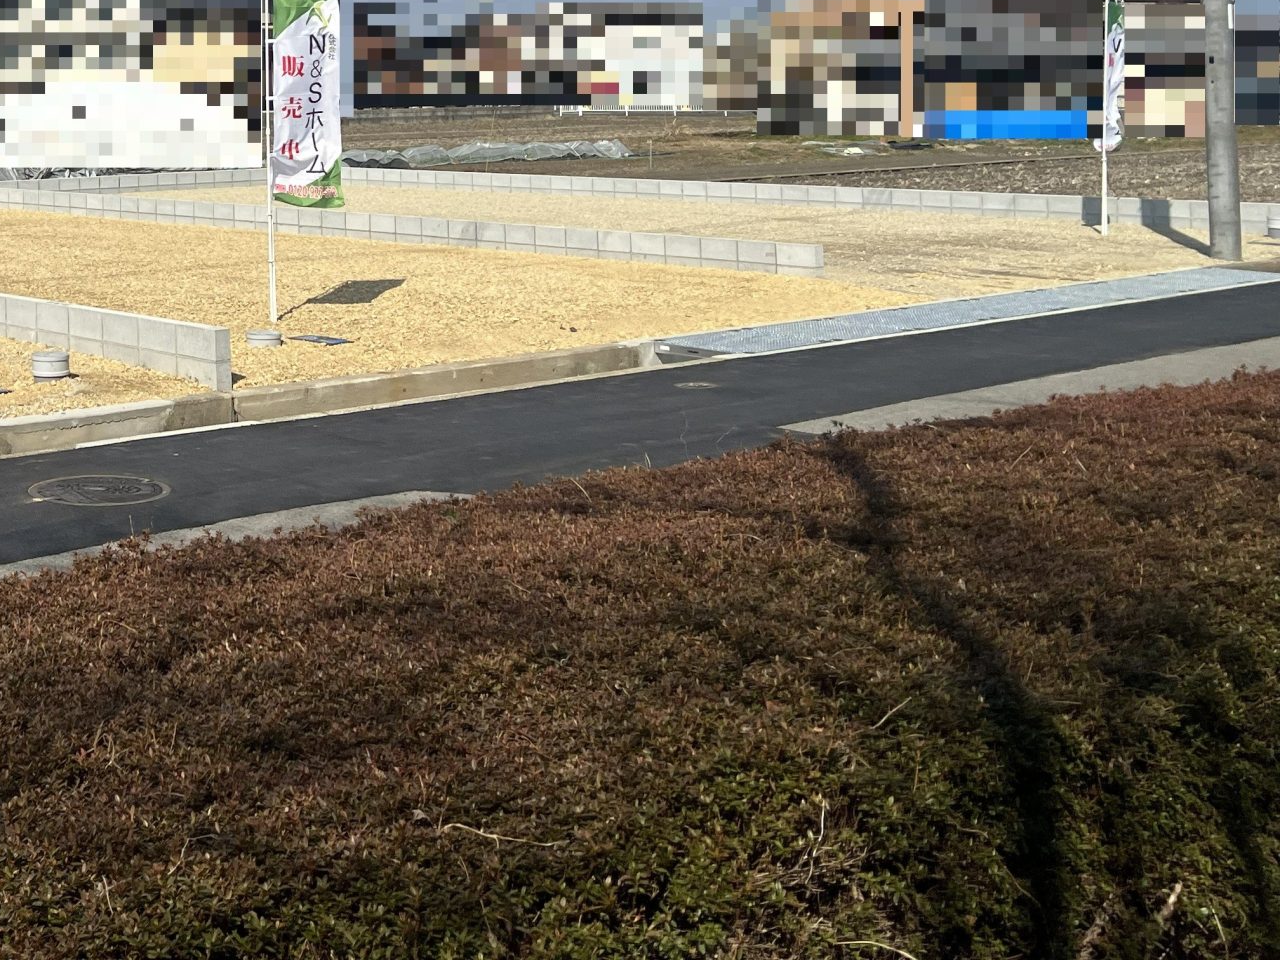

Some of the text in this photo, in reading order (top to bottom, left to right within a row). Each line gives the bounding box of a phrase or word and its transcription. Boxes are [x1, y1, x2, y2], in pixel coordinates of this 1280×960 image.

[281, 55, 304, 161] 販売中
[305, 34, 328, 175] N&Sホーム
